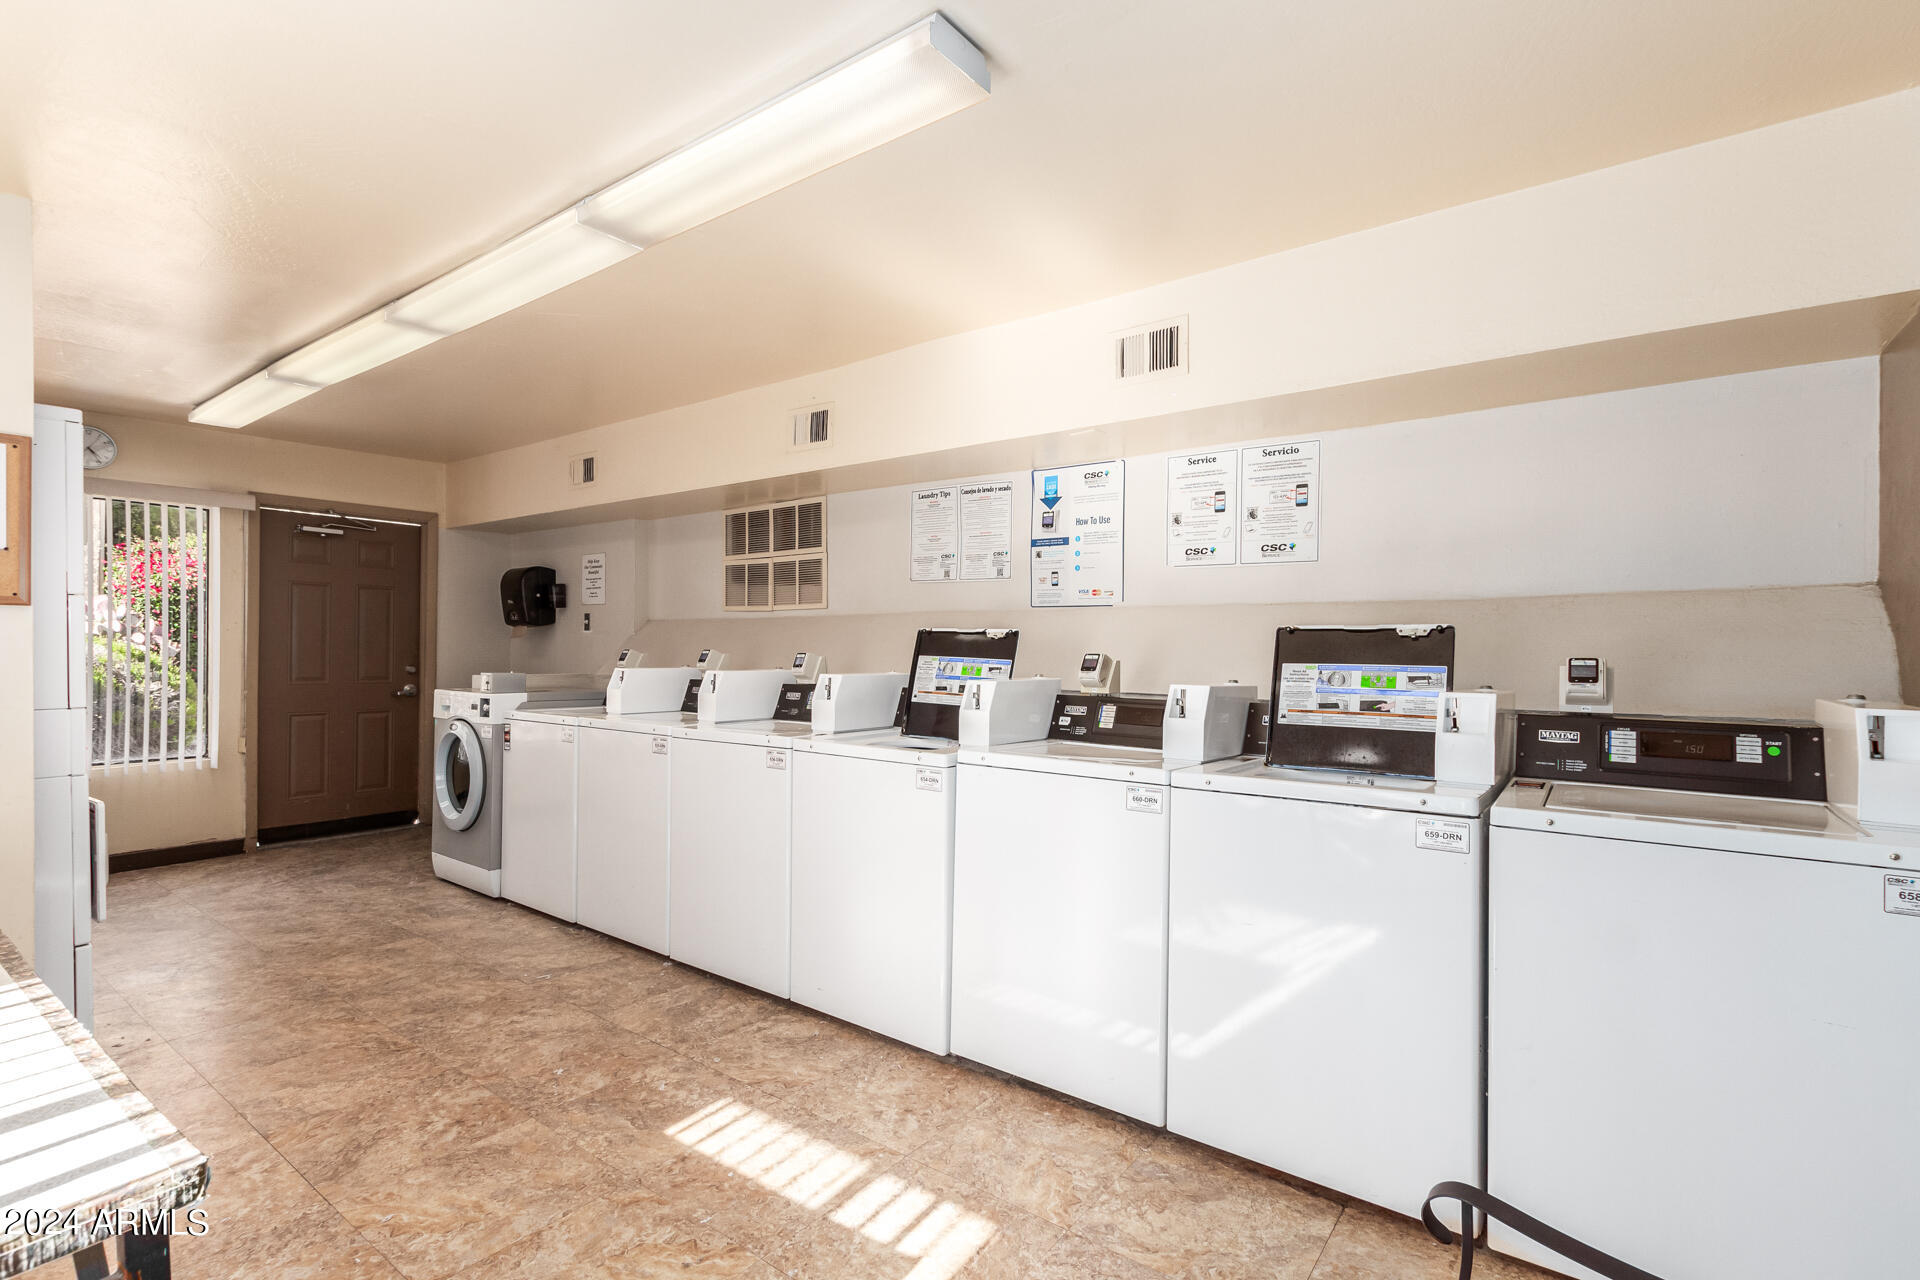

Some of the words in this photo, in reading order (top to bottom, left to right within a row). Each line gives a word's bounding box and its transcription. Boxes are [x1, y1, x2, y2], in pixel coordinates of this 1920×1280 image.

[1262, 446, 1300, 458] Servicio
[1187, 455, 1217, 466] Service
[1084, 471, 1104, 480] CSC
[918, 490, 939, 500] Laundry
[940, 490, 951, 499] Tips
[1075, 517, 1089, 527] How
[1090, 516, 1097, 525] To
[1098, 516, 1111, 524] Use
[1185, 547, 1209, 556] CSC
[1261, 543, 1288, 552] CSC
[1540, 731, 1578, 740] MAYTAG
[1424, 830, 1463, 841] 659-DRN
